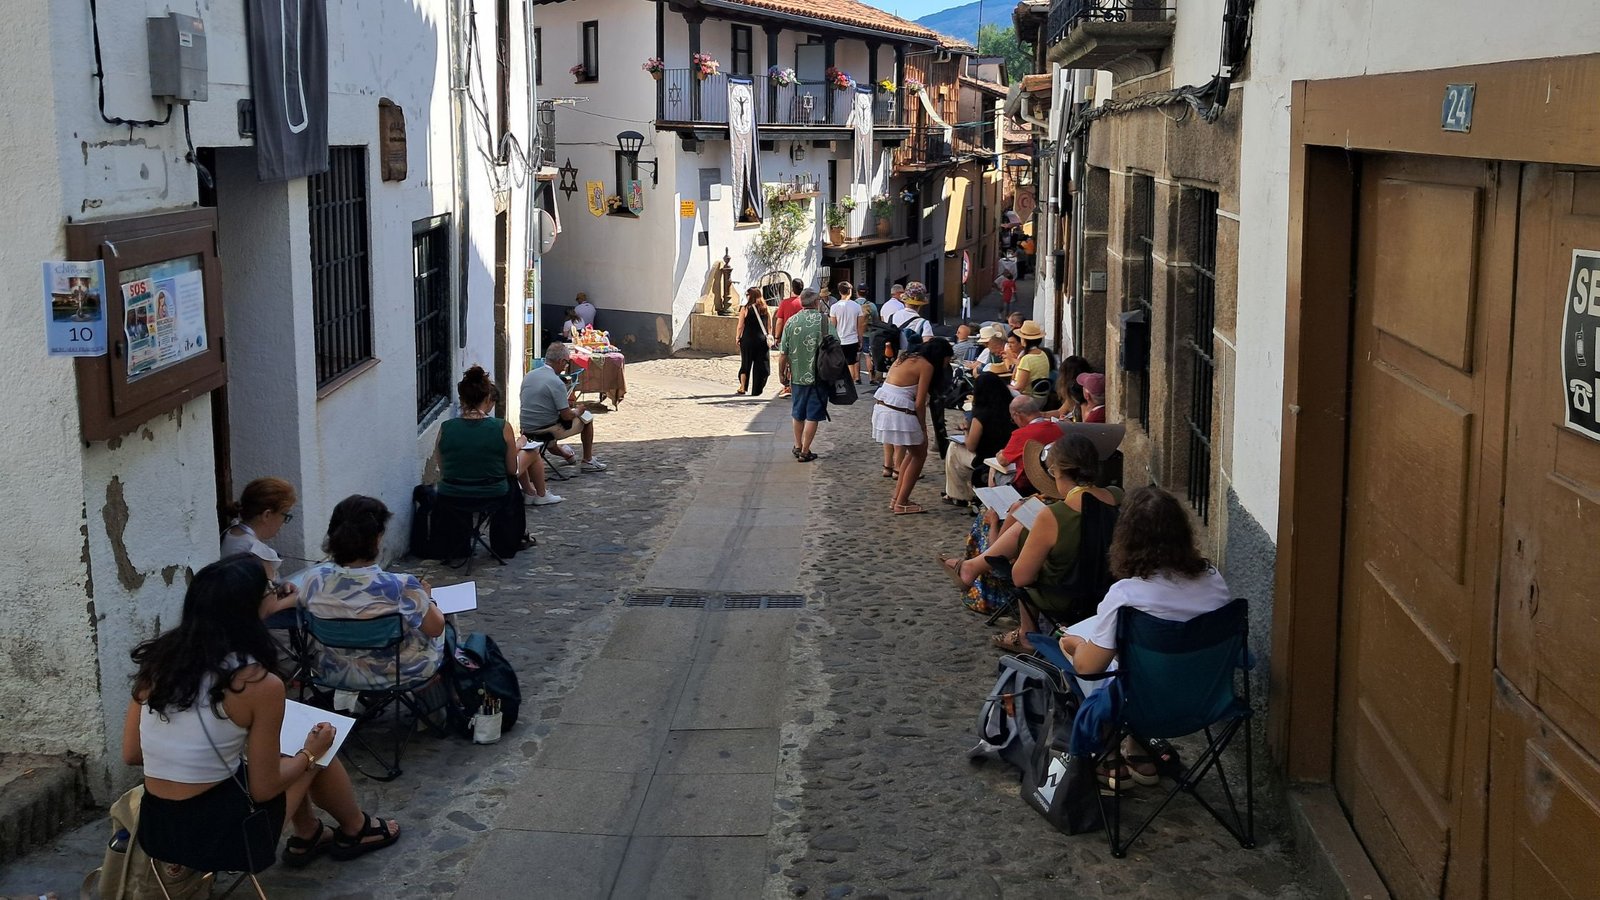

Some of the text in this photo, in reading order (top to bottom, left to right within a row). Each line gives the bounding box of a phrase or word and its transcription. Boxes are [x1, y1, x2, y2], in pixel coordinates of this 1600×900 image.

[1447, 89, 1467, 124] 24
[129, 281, 147, 297] SOS
[1573, 267, 1600, 317] SE
[69, 327, 93, 342] 10
